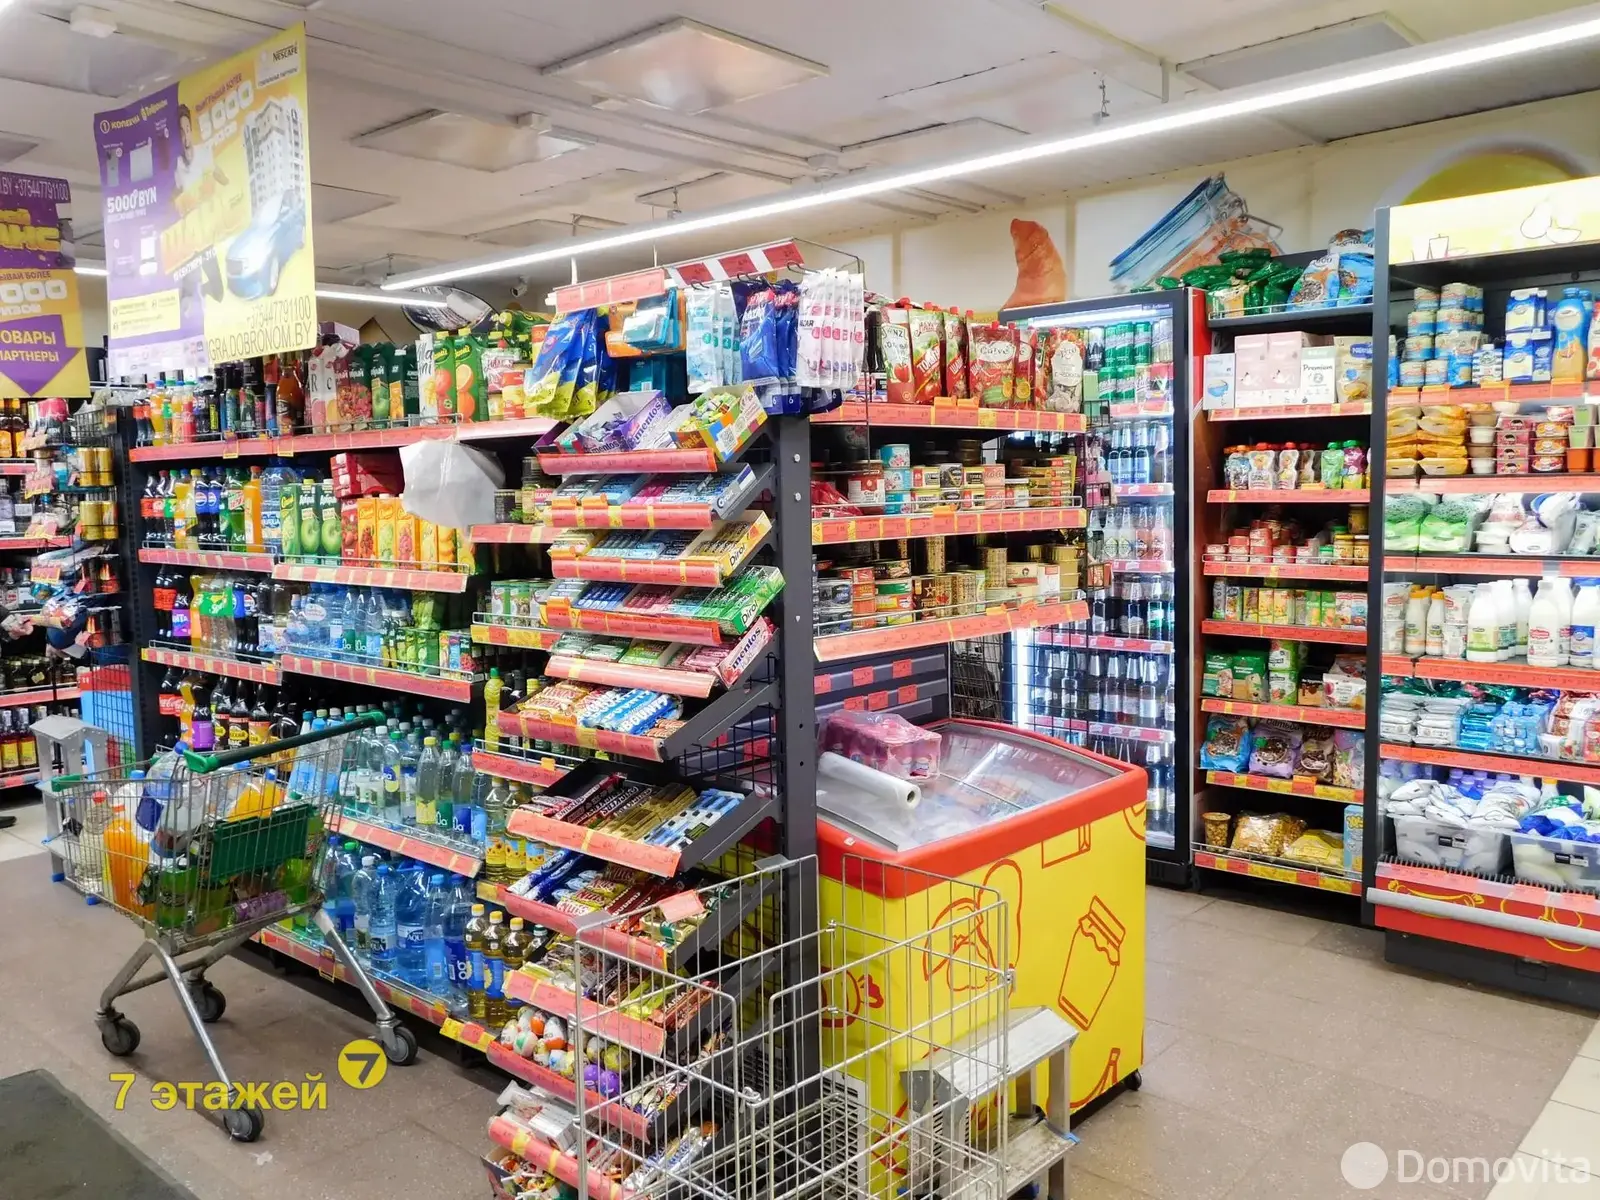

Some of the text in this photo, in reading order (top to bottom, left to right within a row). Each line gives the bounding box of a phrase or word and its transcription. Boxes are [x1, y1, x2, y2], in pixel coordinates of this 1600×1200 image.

[15, 178, 68, 200] +375447791100
[138, 187, 157, 209] BYN
[0, 279, 67, 302] 000
[0, 329, 56, 345] ОВАРЫ
[1302, 364, 1333, 372] Premium
[637, 399, 662, 443] mentos
[729, 545, 746, 567] Dirol
[741, 601, 759, 625] Dirol
[732, 626, 761, 669] mentos
[622, 693, 668, 731] BOUNTY
[575, 889, 606, 905] Nuts
[556, 902, 591, 916] Nuts
